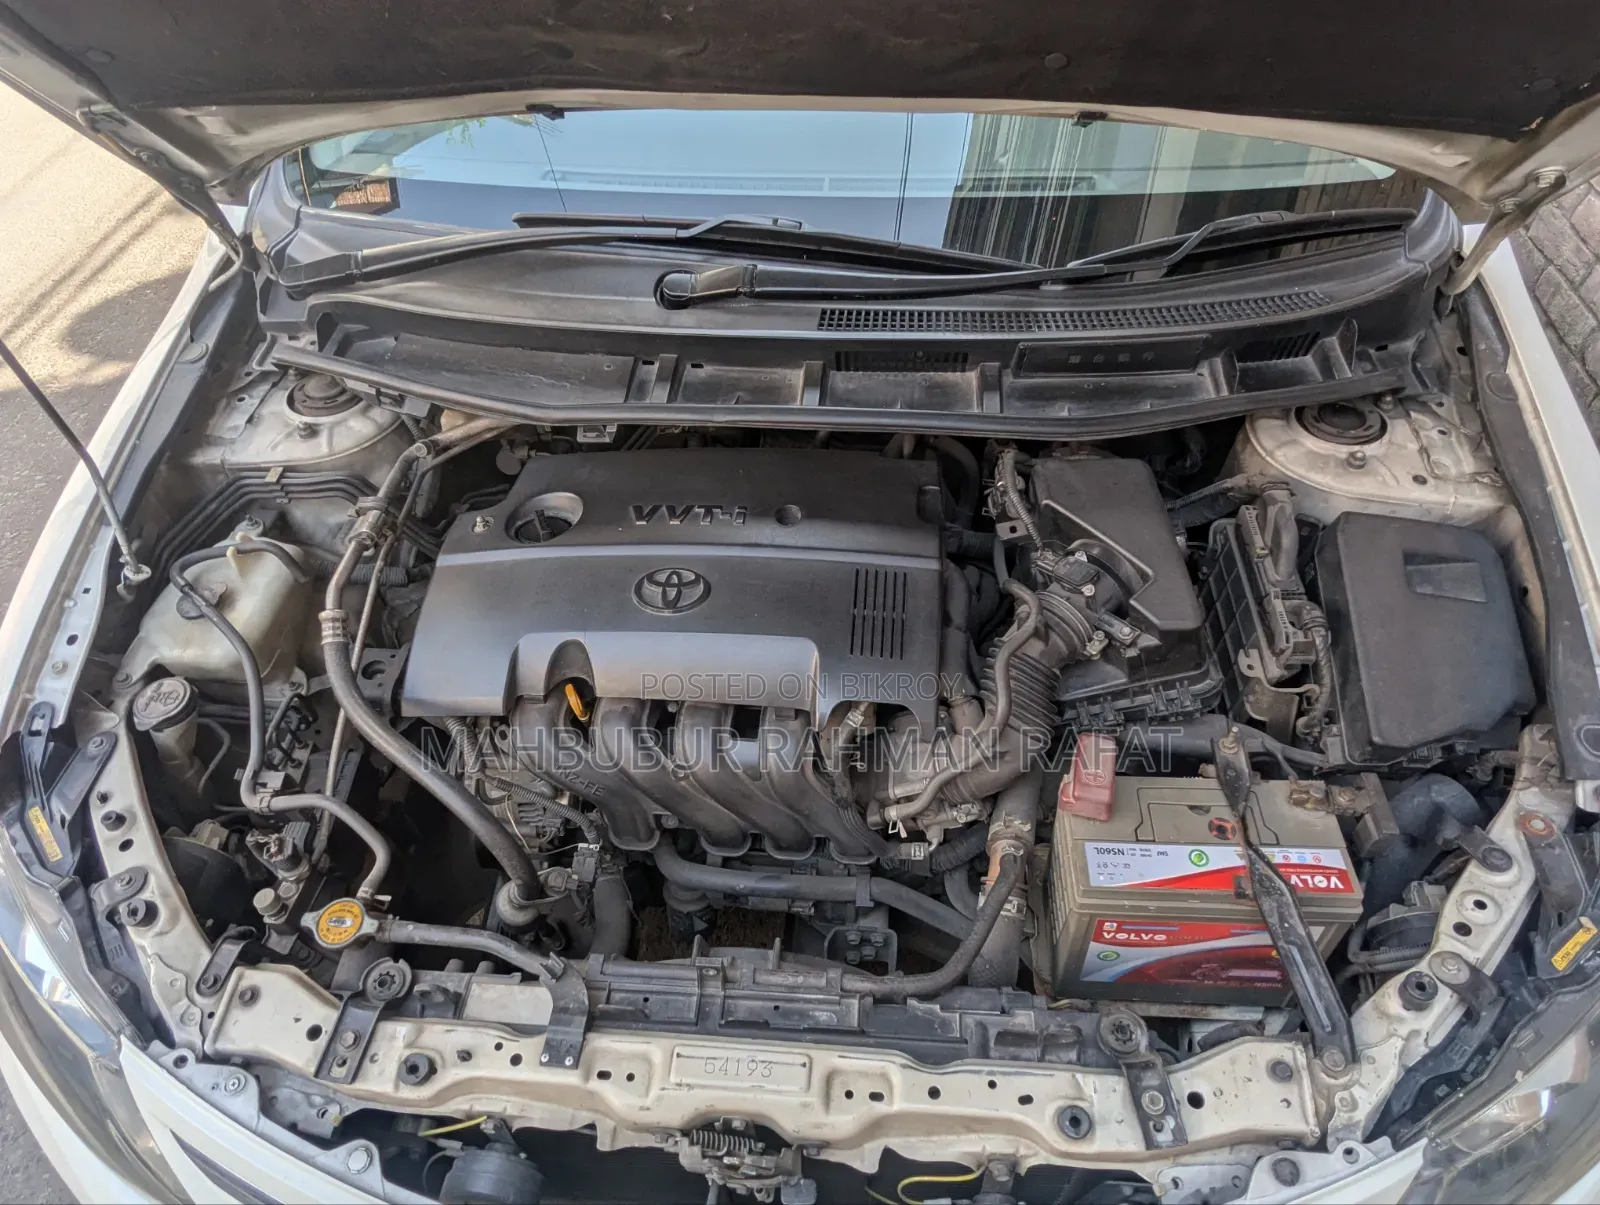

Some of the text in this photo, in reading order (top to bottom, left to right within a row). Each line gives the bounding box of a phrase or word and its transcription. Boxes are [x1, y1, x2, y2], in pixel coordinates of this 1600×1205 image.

[629, 503, 748, 526] VVT-i
[1093, 846, 1125, 856] NS60L
[1290, 874, 1345, 889] VOLV
[1102, 932, 1167, 941] VOLVO
[704, 1056, 773, 1078] 54193
